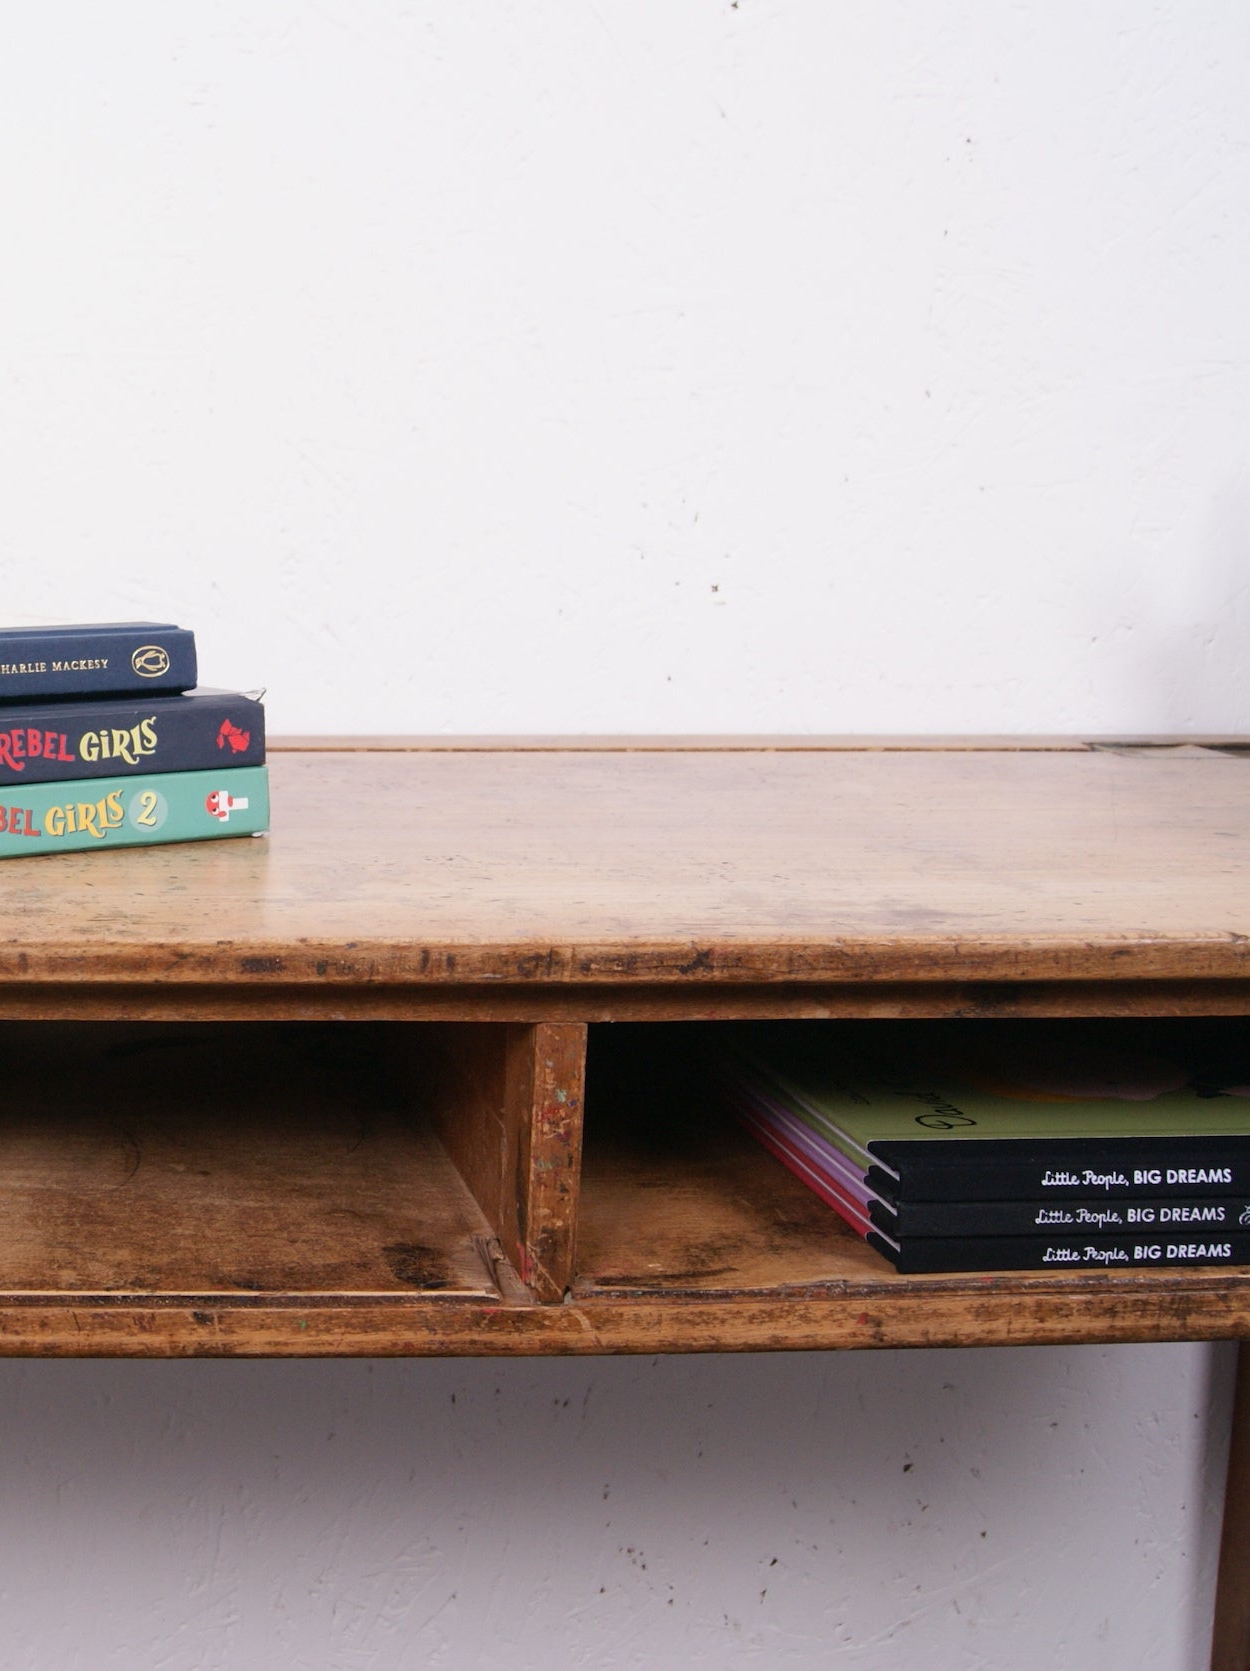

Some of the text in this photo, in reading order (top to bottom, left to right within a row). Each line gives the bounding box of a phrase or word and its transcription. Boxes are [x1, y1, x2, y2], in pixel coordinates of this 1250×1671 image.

[52, 658, 109, 673] MACKESY
[137, 791, 158, 827] 2
[1041, 1168, 1232, 1190] Little People, BIG DREAMS
[1035, 1207, 1225, 1229] Little People, BIG DREAMS
[1042, 1243, 1232, 1265] Little People, BIG DREAMS
